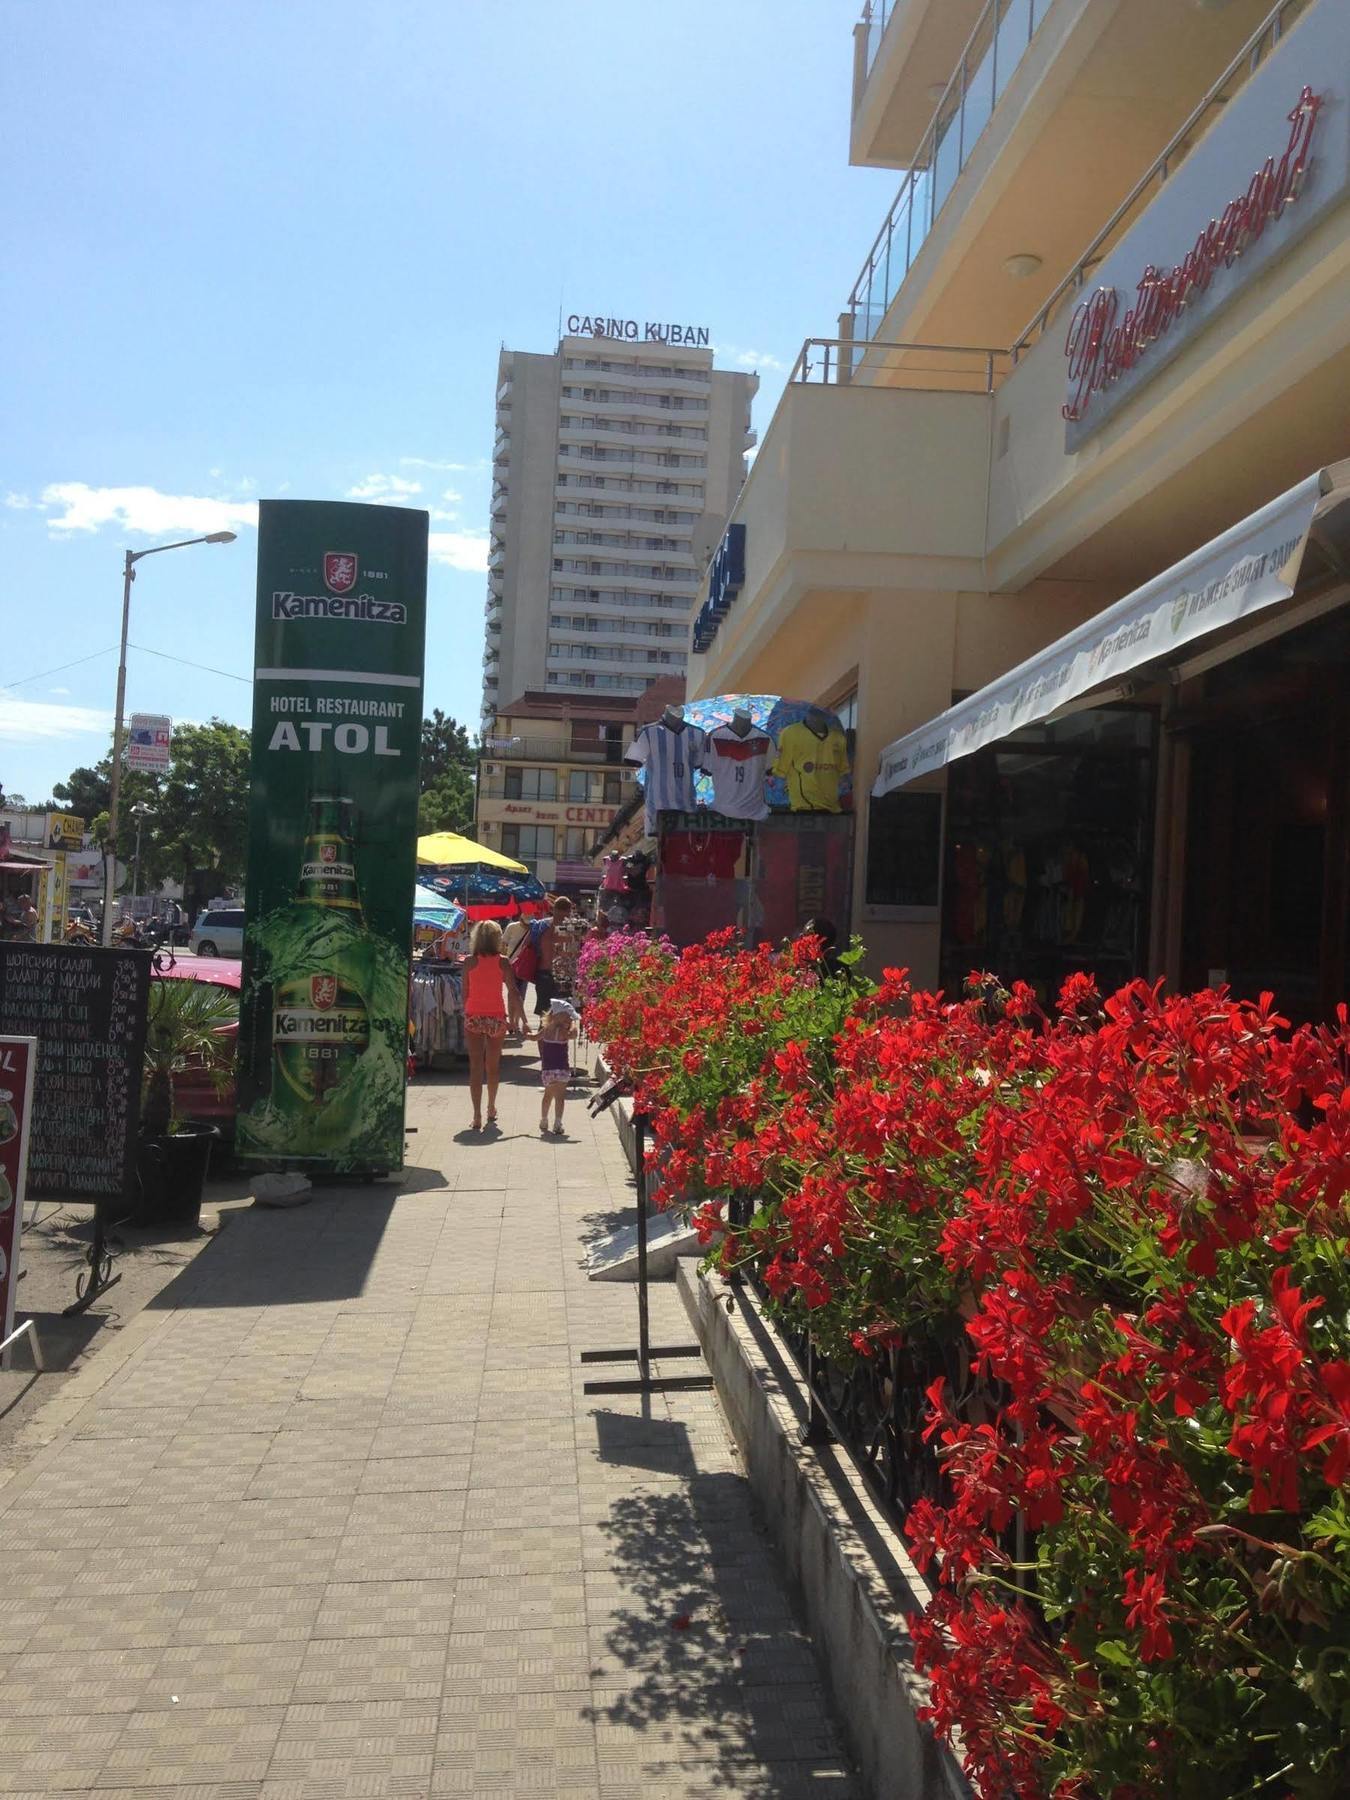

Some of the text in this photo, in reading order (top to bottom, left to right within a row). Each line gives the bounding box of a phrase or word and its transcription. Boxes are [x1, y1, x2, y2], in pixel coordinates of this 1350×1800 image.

[567, 314, 709, 345] CASINO KUBAN
[272, 591, 408, 624] Kamenitza
[270, 696, 405, 718] HOTEL RESTAURANT
[268, 721, 401, 756] ATOL
[673, 762, 685, 778] 10
[735, 766, 745, 783] 19
[565, 808, 617, 822] CENTR
[302, 864, 354, 876] Kamenitza
[275, 1014, 370, 1035] Kamenitza
[303, 1047, 338, 1058] 1881
